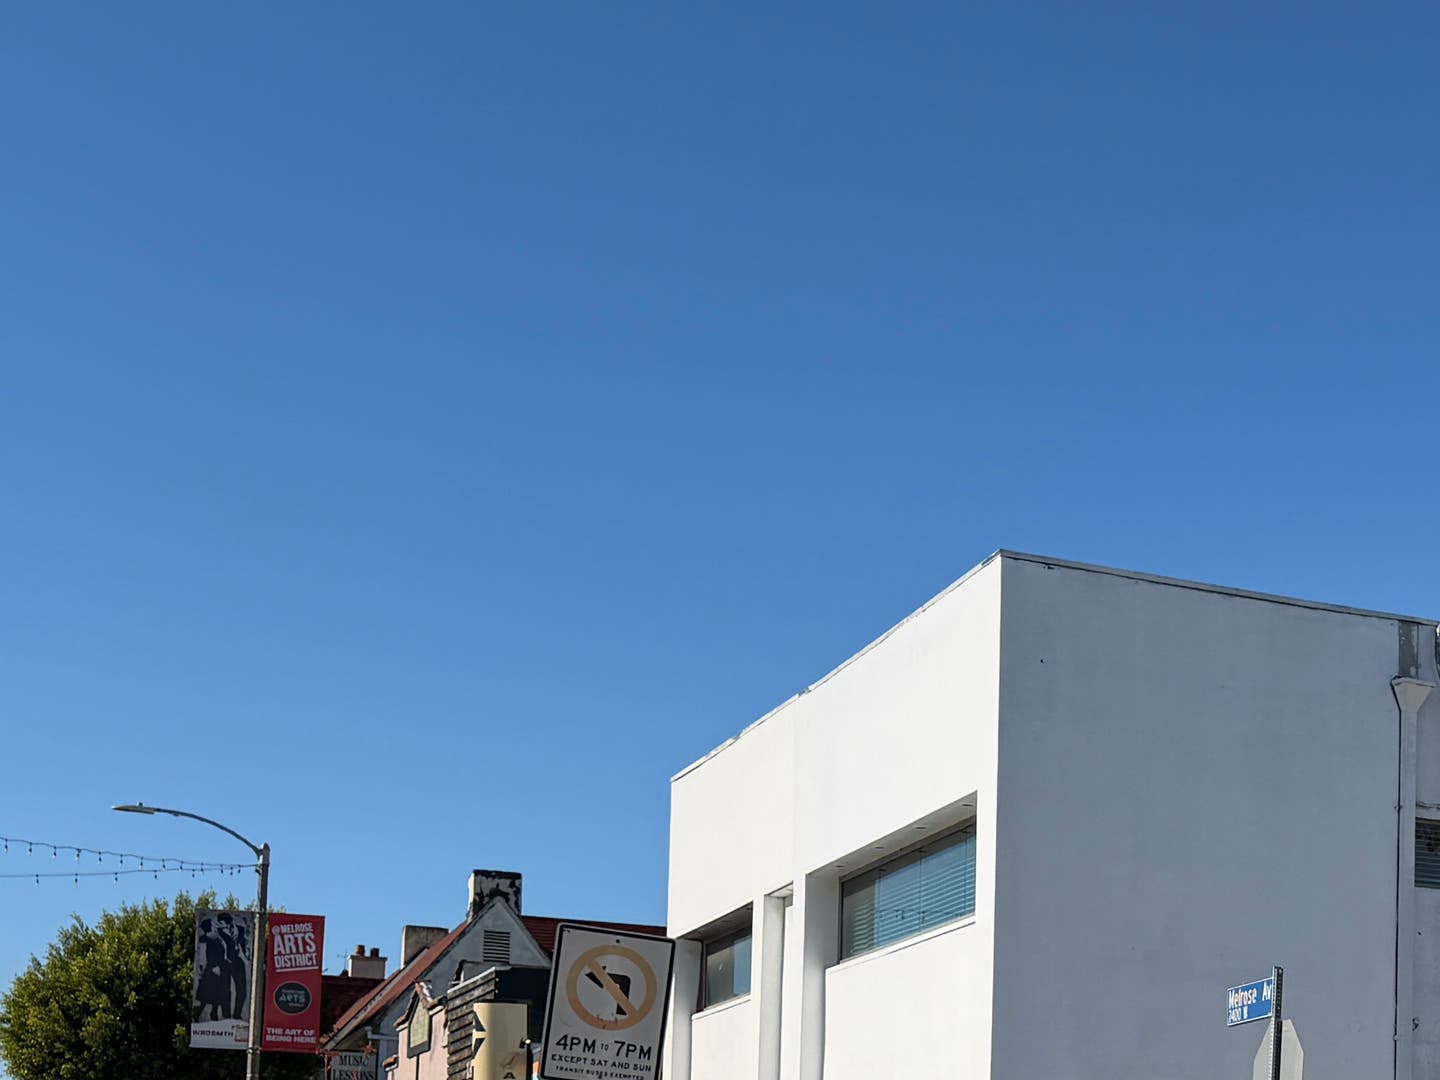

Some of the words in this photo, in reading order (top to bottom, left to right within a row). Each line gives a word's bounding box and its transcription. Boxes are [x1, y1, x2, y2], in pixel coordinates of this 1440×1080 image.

[273, 933, 317, 955] ARTS
[273, 953, 318, 968] DISTRICT
[1228, 988, 1257, 1009] Melrose
[265, 1034, 292, 1043] BEING
[293, 1035, 317, 1044] HERE
[266, 1027, 283, 1035] THE
[284, 1028, 302, 1036] ART
[303, 1029, 316, 1037] OF
[555, 1034, 597, 1054] 4PM
[614, 1040, 652, 1060] 7PM
[339, 1055, 369, 1067] MUSIC
[551, 1053, 587, 1065] EXCEPT
[591, 1058, 608, 1067] SAT
[611, 1062, 630, 1070] AND
[633, 1064, 651, 1072] SUN
[555, 1066, 584, 1074] TRANSIT
